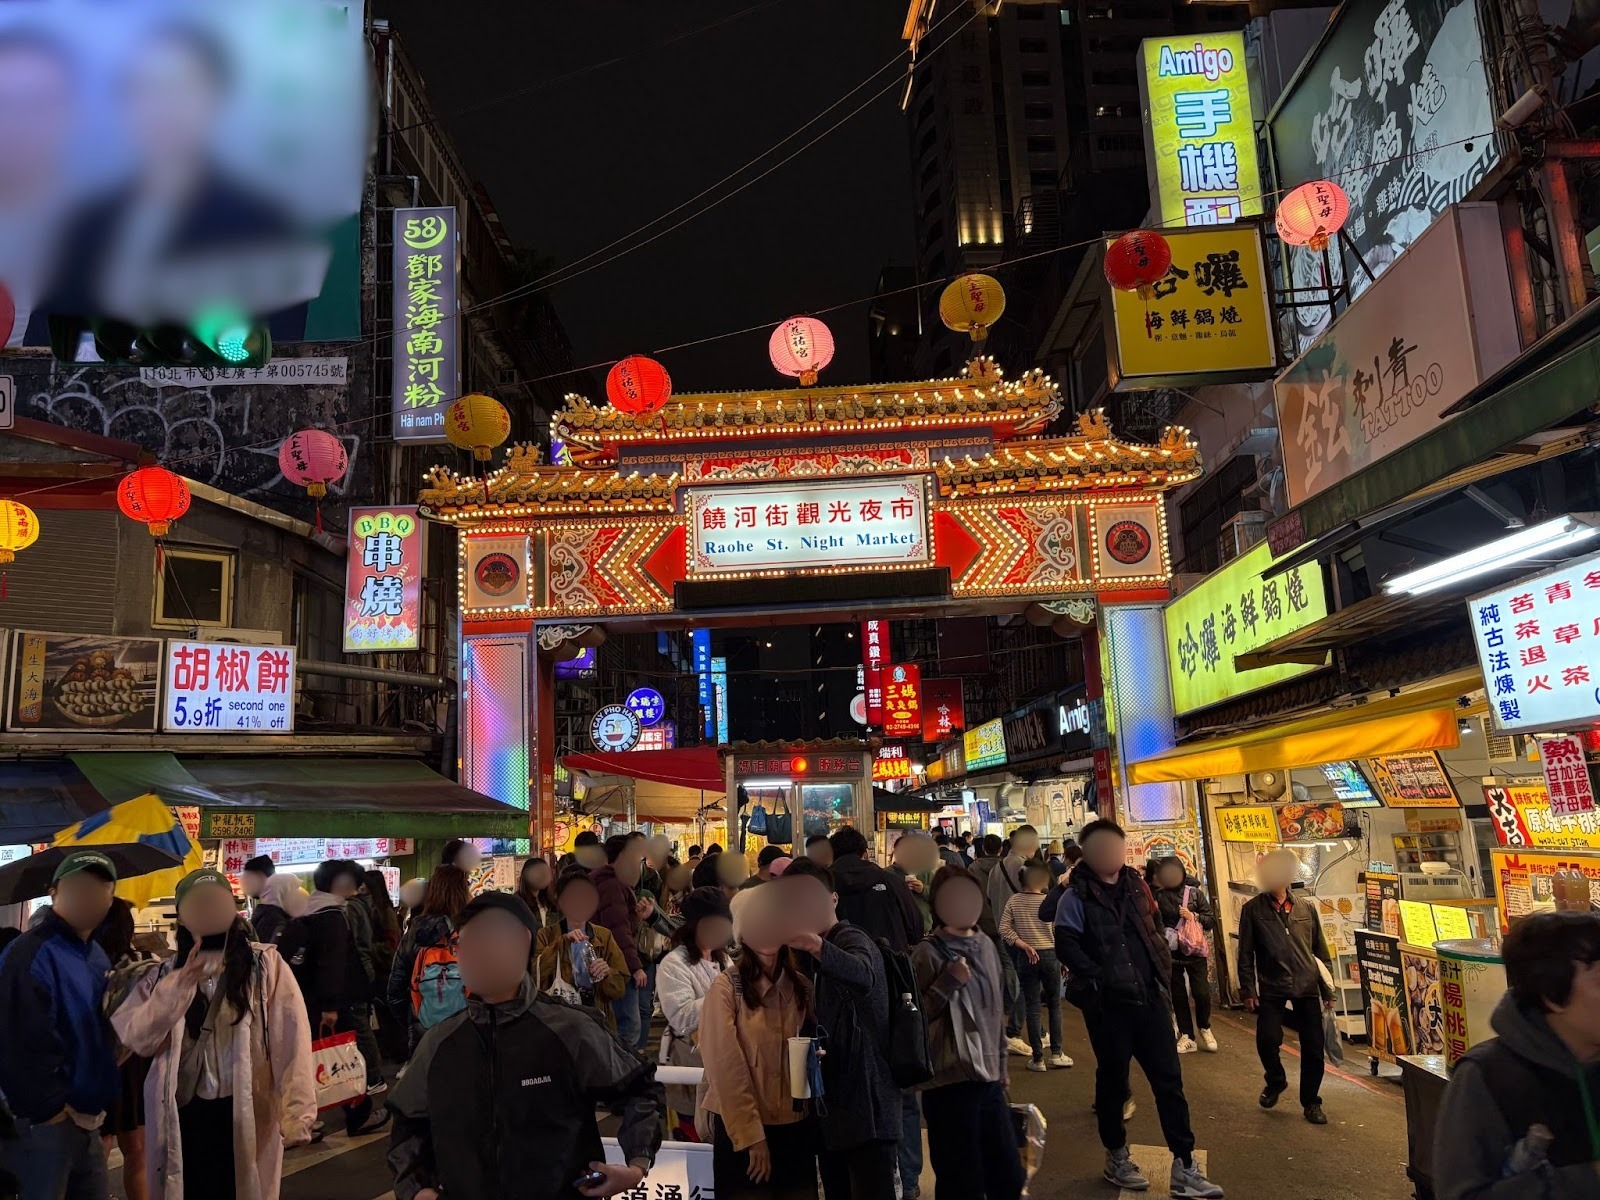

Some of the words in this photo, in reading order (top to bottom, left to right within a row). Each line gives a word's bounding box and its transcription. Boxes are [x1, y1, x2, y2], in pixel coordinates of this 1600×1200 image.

[1158, 43, 1234, 82] Amigo
[405, 216, 438, 239] 58
[1133, 236, 1150, 268] 上聖母
[403, 254, 446, 408] 鄧家海南河粉
[1352, 336, 1418, 417] 刺青
[415, 416, 432, 428] nam
[433, 413, 445, 428] Ph
[1360, 362, 1443, 444] TATTOO
[361, 517, 410, 533] BBQ
[702, 497, 914, 530] 饒河街觀光夜市
[705, 540, 754, 555] Raohe
[766, 538, 788, 551] St.
[800, 535, 845, 551] Night
[856, 531, 915, 547] Market
[360, 531, 403, 617] 串燒
[1509, 592, 1553, 695] 苦茶退火
[1545, 580, 1590, 687] 青草茶
[173, 646, 290, 694] 胡椒餅
[1479, 603, 1522, 721] 純古法煉製
[228, 699, 263, 711] second
[268, 702, 285, 712] one
[886, 684, 916, 699] 三媽
[174, 697, 223, 727] 5.9折
[237, 716, 261, 728] 41%
[271, 717, 285, 728] off
[603, 706, 621, 716] PHO
[937, 704, 951, 728] 哈林
[1059, 699, 1089, 736] Amig
[1542, 738, 1582, 766] 熱
[1546, 767, 1566, 814] 甘蔗汁
[1560, 765, 1580, 812] 加薑母
[1573, 763, 1594, 810] 治咳嗽
